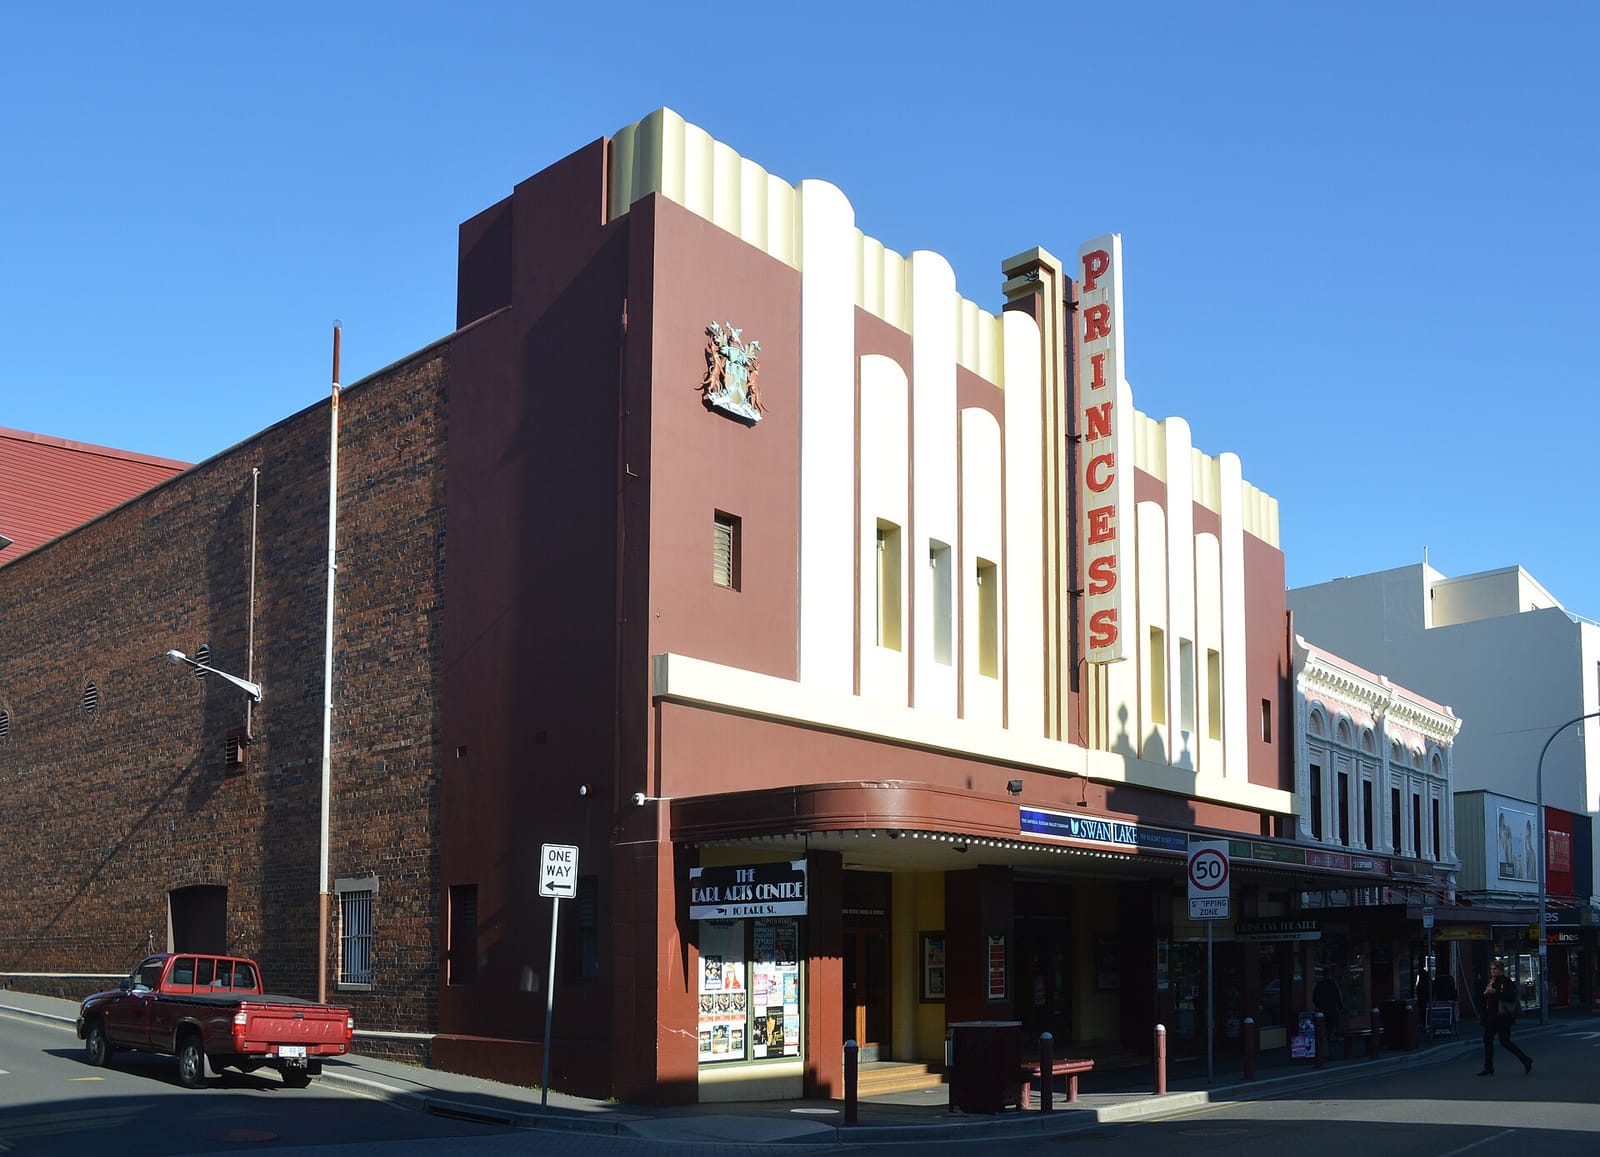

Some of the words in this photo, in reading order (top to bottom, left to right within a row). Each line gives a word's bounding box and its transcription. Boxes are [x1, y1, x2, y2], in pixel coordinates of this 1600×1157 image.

[1082, 249, 1119, 650] PRINCESS
[1080, 820, 1111, 841] SWAN
[1113, 823, 1138, 844] LAKE
[549, 850, 571, 862] ONE
[547, 865, 571, 877] WAY
[736, 868, 757, 883] THE
[1196, 860, 1221, 880] 50
[691, 887, 720, 903] EARL
[724, 884, 753, 901] ARTS
[755, 882, 803, 900] CENTRE
[1199, 908, 1219, 917] ZONE
